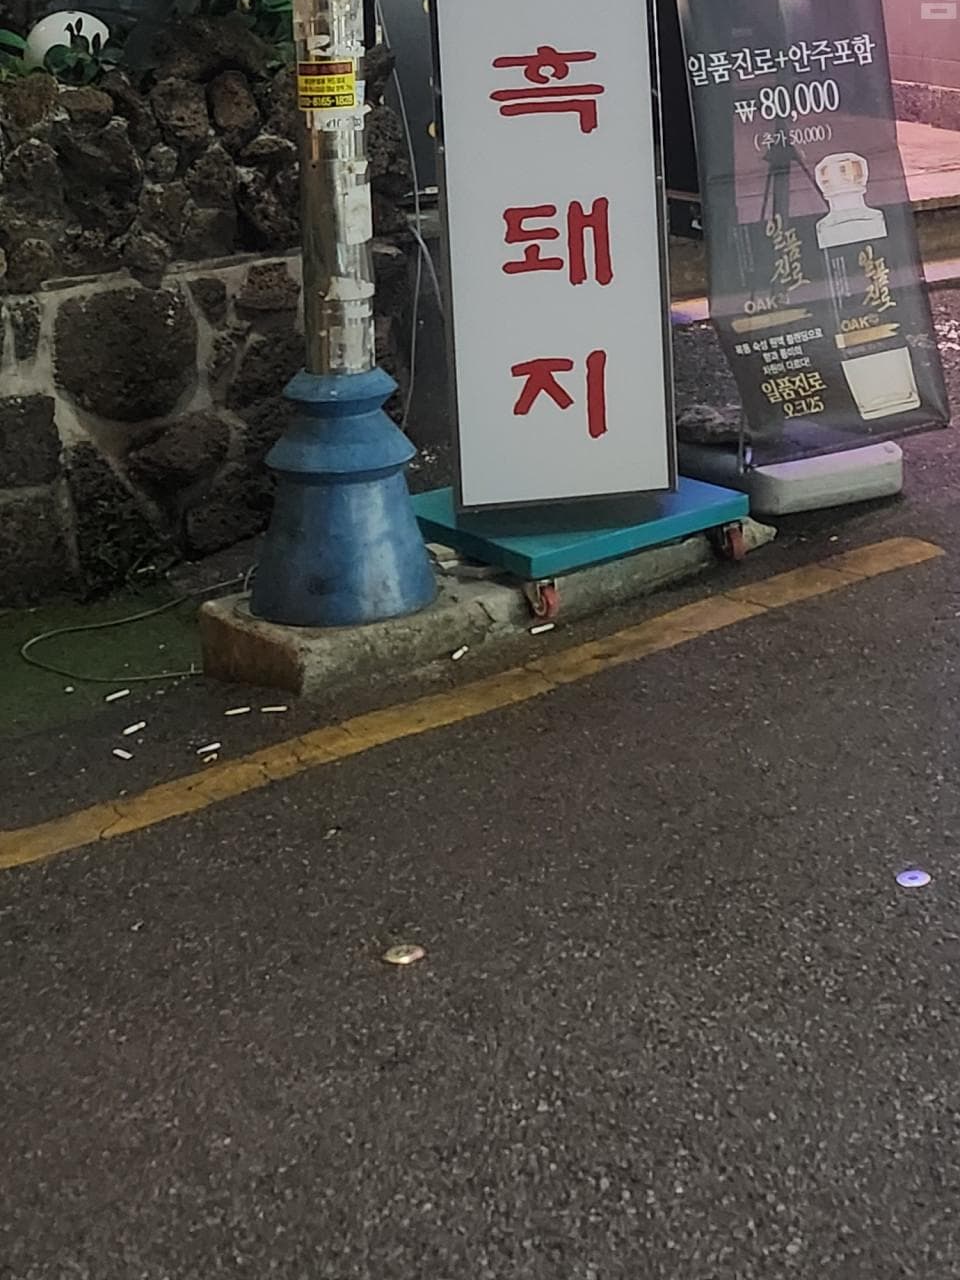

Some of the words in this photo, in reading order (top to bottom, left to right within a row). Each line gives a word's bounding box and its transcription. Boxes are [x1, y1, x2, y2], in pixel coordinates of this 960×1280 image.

[688, 34, 875, 86] 일품진로+안주포함
[490, 45, 612, 438] 흑돼지
[761, 372, 828, 404] 일품진로
